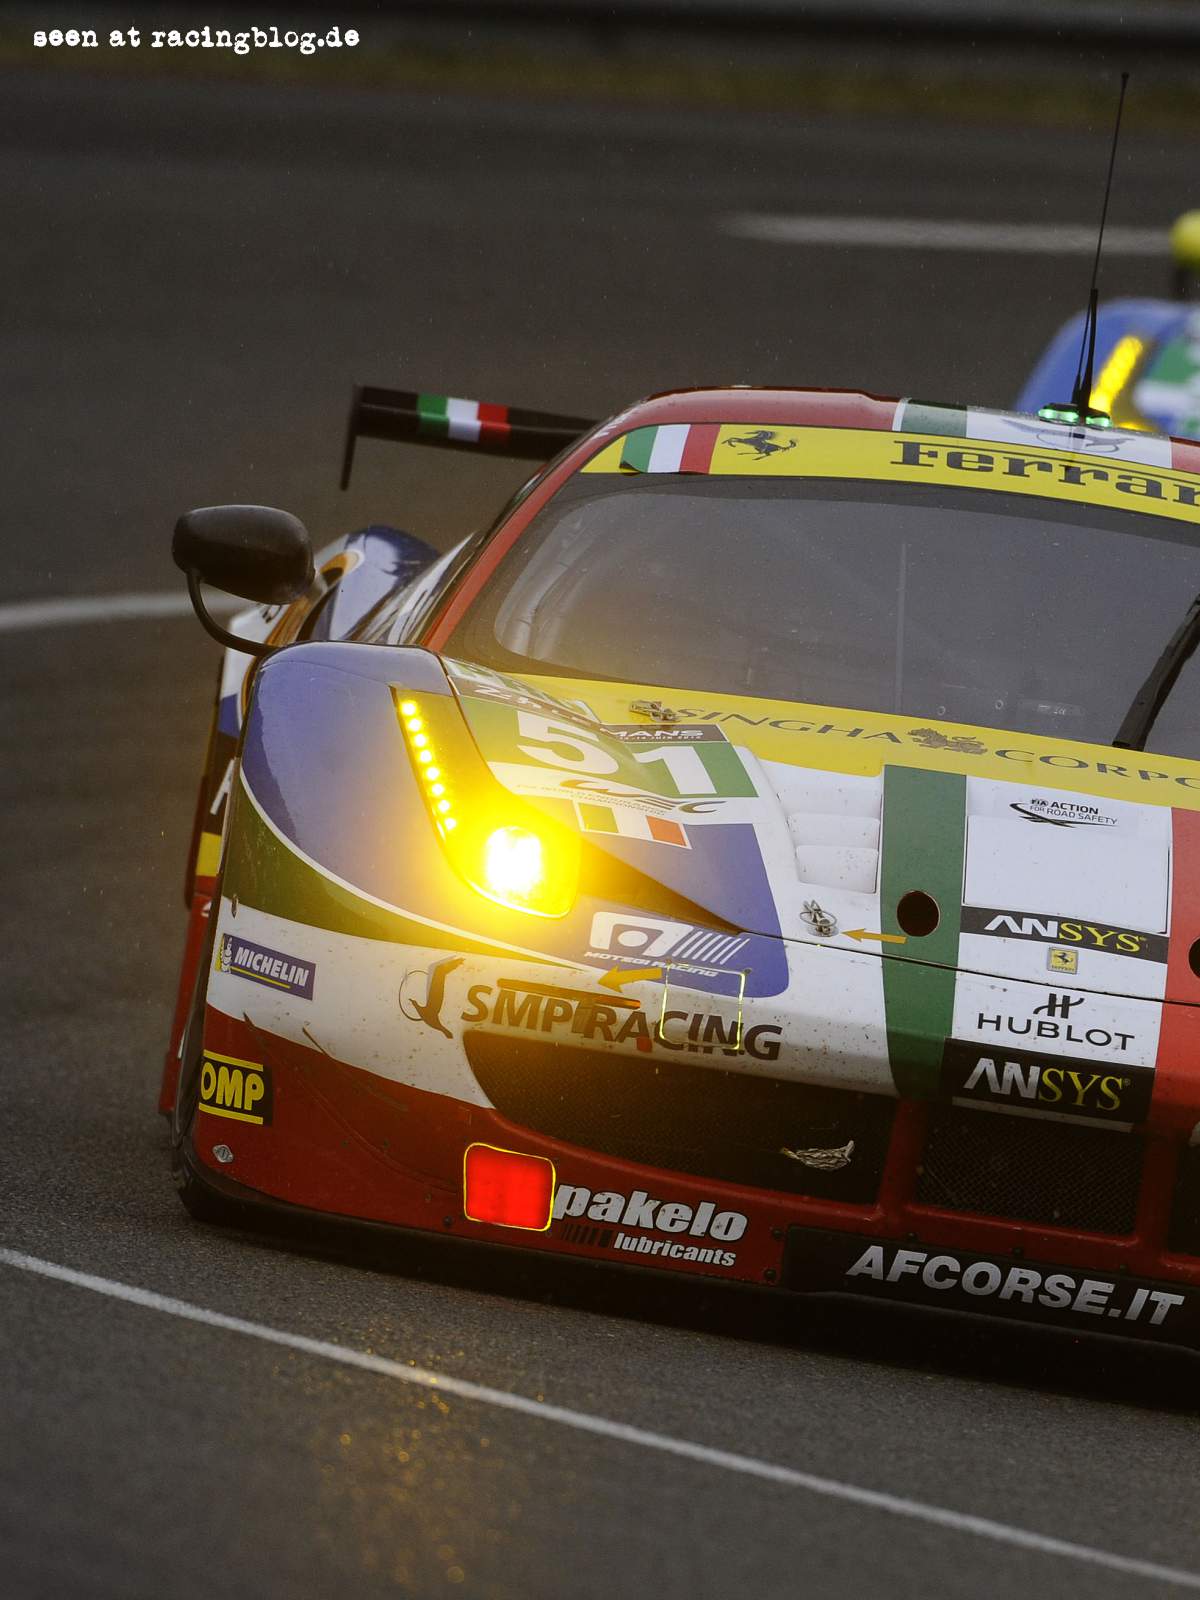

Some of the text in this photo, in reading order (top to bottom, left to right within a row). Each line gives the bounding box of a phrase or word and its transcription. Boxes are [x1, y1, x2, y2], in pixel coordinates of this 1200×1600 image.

[676, 707, 903, 745] SINGHA
[517, 710, 718, 795] 51
[1046, 808, 1076, 818] ROAD
[1077, 812, 1118, 825] SAFETY
[1050, 801, 1099, 814] ACTION
[234, 946, 310, 988] MICHELIN
[461, 985, 783, 1060] SMP RACING
[977, 1012, 1136, 1051] HUBLOT
[200, 1061, 265, 1111] OMP
[551, 1184, 748, 1242] pakelo
[613, 1232, 737, 1267] lubricants
[845, 1245, 1185, 1326] AFCORSE.IT
